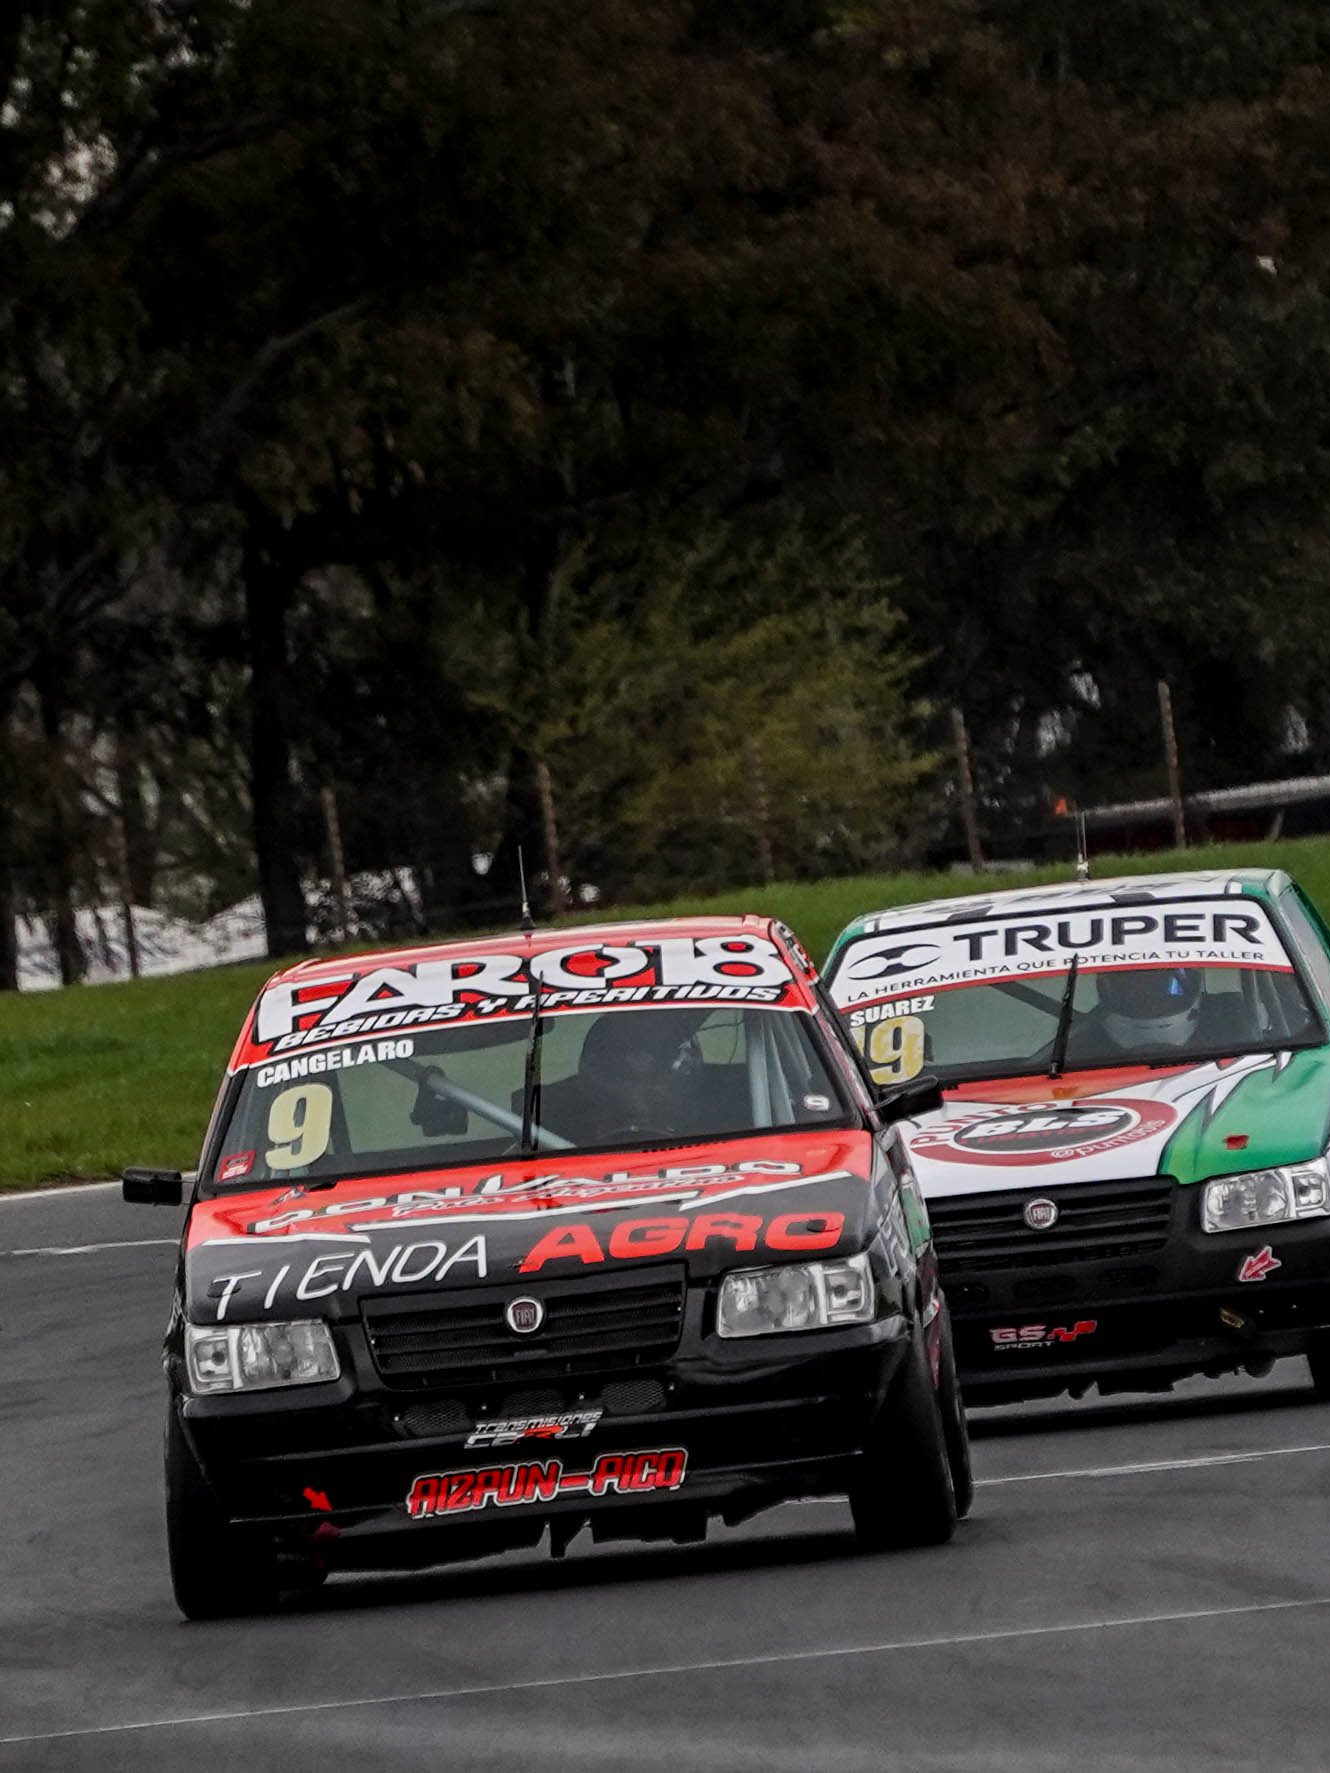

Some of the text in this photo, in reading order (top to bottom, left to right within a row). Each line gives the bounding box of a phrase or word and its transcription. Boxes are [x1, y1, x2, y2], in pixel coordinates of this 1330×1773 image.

[953, 913, 1264, 962] TRUPER
[847, 950, 1265, 1002] LA HERRAMIENTA QUE POTENCIA TU TALLER
[273, 984, 781, 1051] BEBIDAS Y APERITIVOS
[850, 995, 935, 1027] SUAREZ
[256, 1039, 414, 1088] CANGELARO
[265, 1083, 333, 1170] 9
[910, 1103, 1058, 1146] PUNTO
[960, 1110, 1129, 1139] BLS
[212, 1234, 488, 1321] TIENDA
[518, 1211, 846, 1274] AGRO
[989, 1325, 1047, 1343] GS
